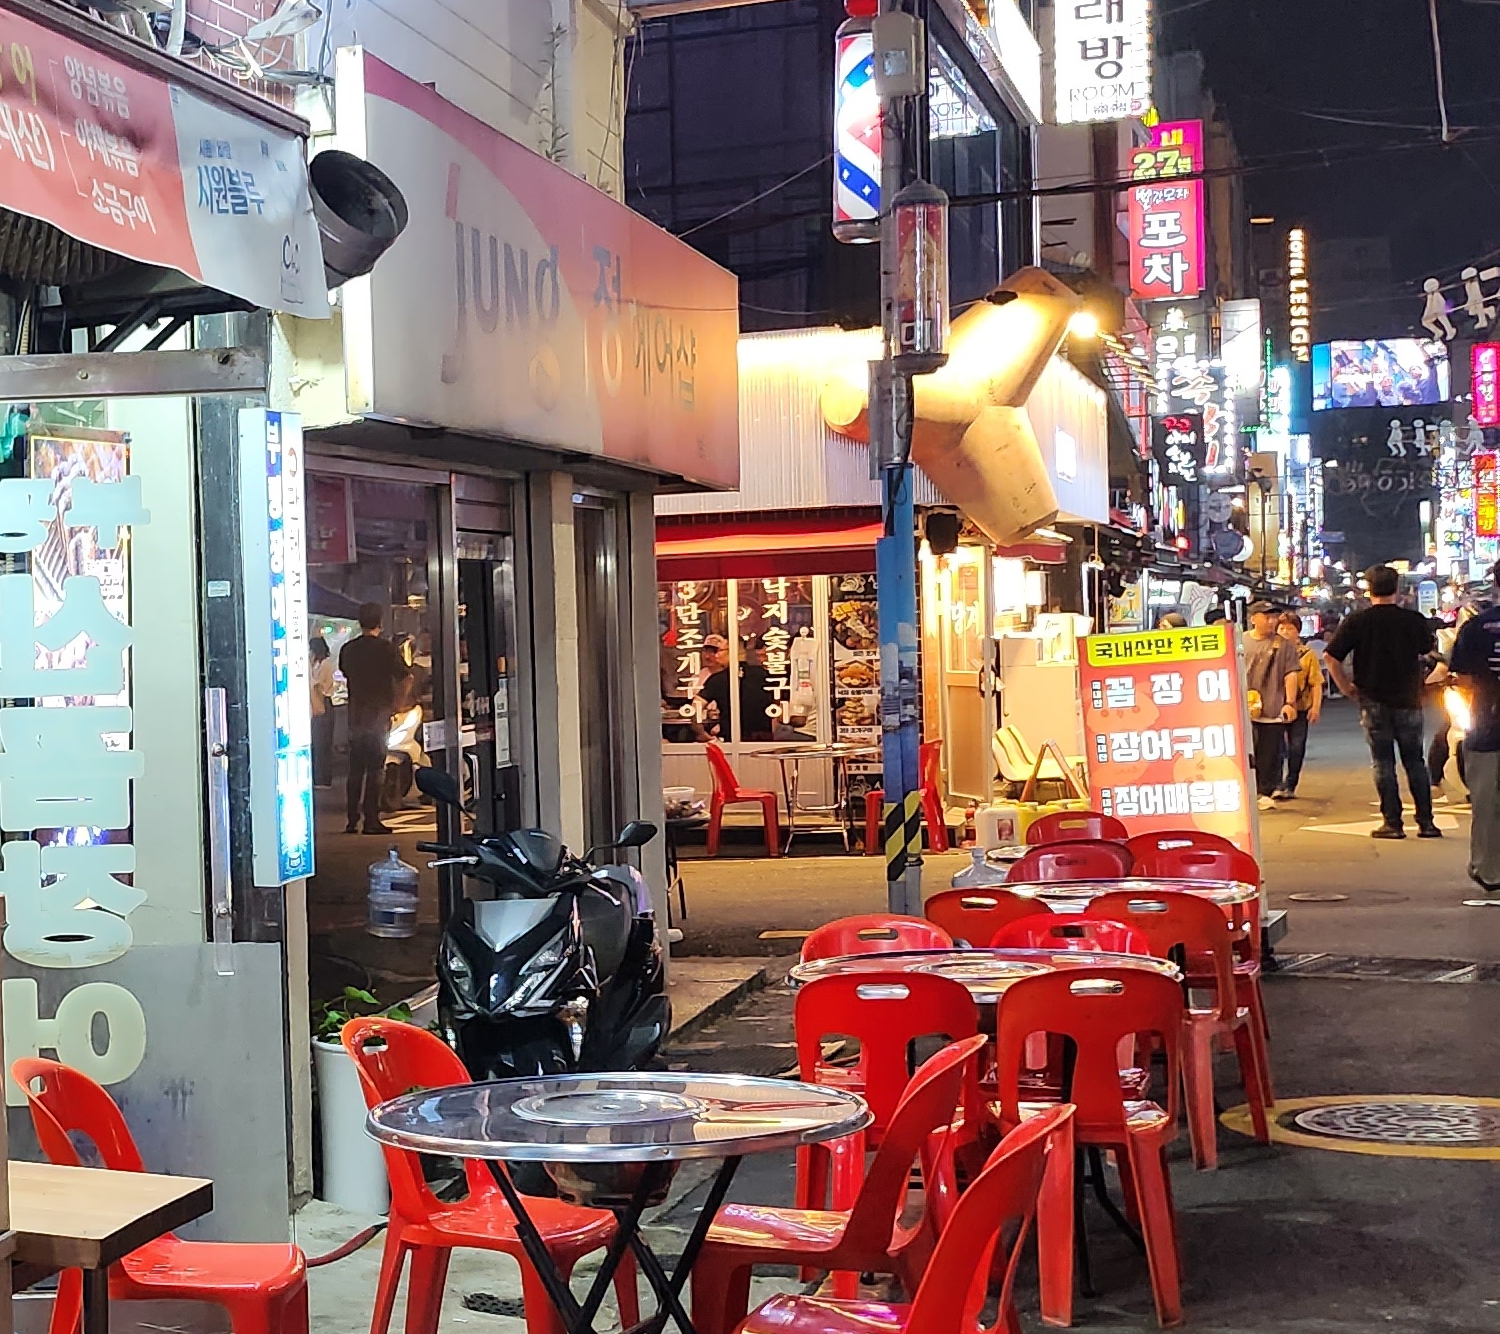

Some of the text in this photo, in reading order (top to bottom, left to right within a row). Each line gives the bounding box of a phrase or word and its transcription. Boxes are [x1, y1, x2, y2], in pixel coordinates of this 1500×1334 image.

[1069, 81, 1135, 103] ROOM
[91, 178, 157, 235] 소금구이
[197, 164, 265, 216] 시원블루
[1135, 187, 1190, 212] 빨간모자
[1139, 212, 1190, 294] 포차
[1094, 633, 1220, 660] 국내산만 취급
[1109, 723, 1236, 763] 장어구이
[1113, 779, 1241, 817] 장어매운탕
